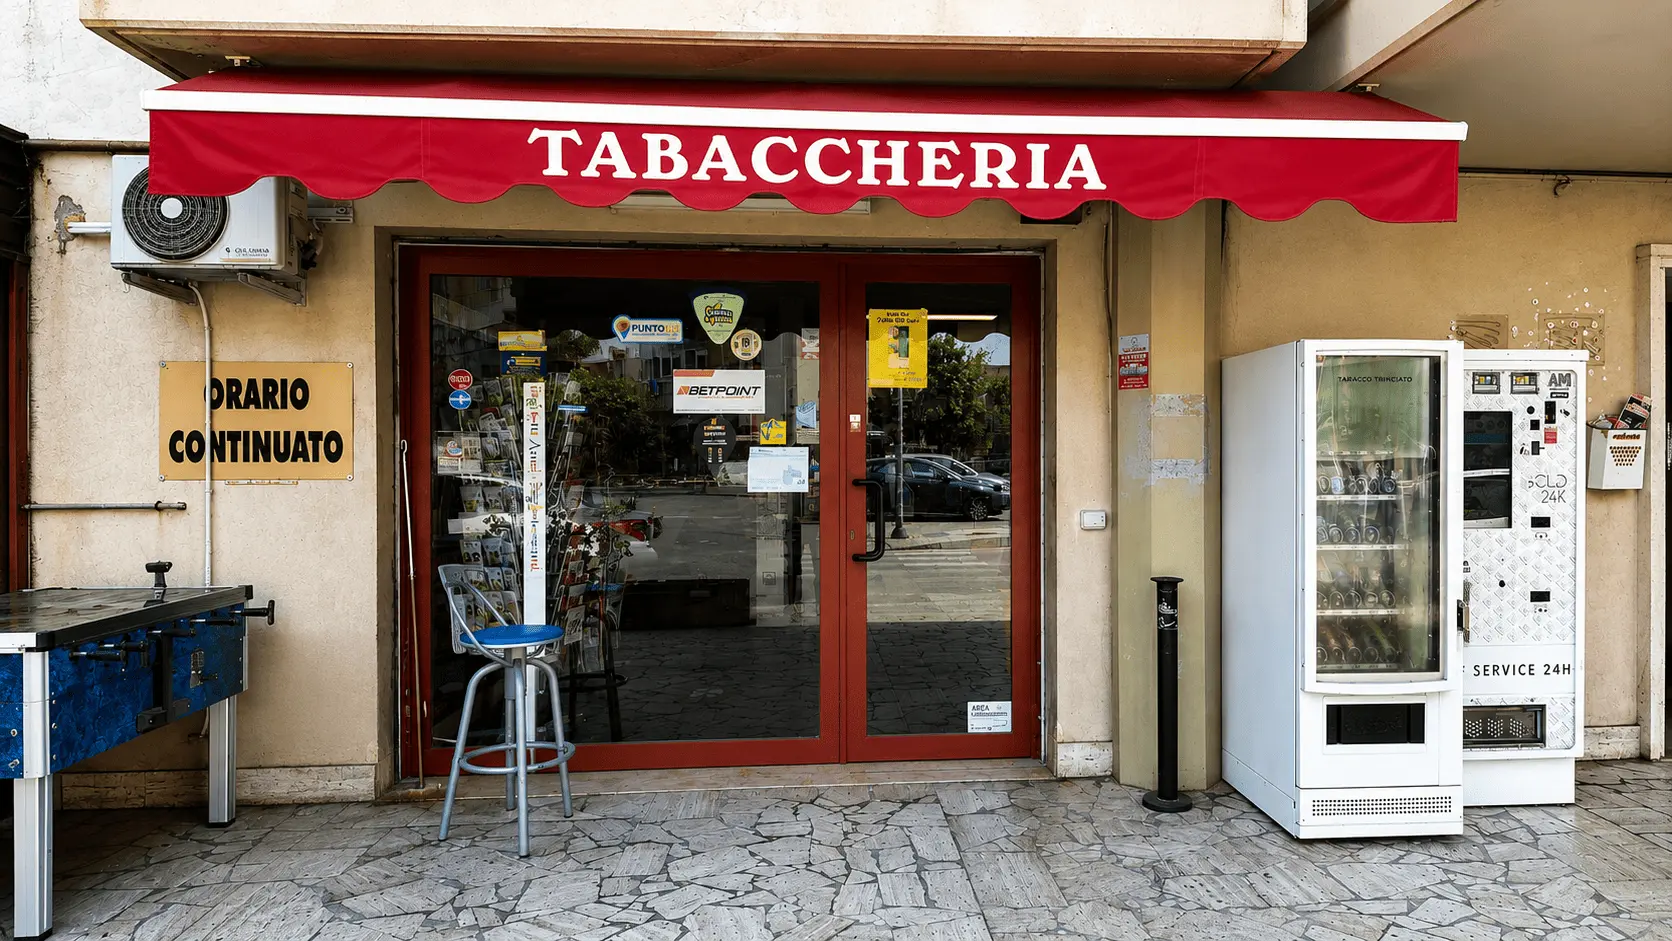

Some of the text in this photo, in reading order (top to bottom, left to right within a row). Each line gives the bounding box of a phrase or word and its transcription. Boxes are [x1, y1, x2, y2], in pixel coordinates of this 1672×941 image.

[527, 127, 1107, 190] TABACCHERIA
[203, 377, 310, 411] ORARIO
[688, 385, 762, 396] BETPOINT
[169, 430, 344, 464] CONTINUATO
[1541, 489, 1567, 504] 24K
[1473, 664, 1535, 677] SERVICE
[1543, 663, 1571, 676] 24H
